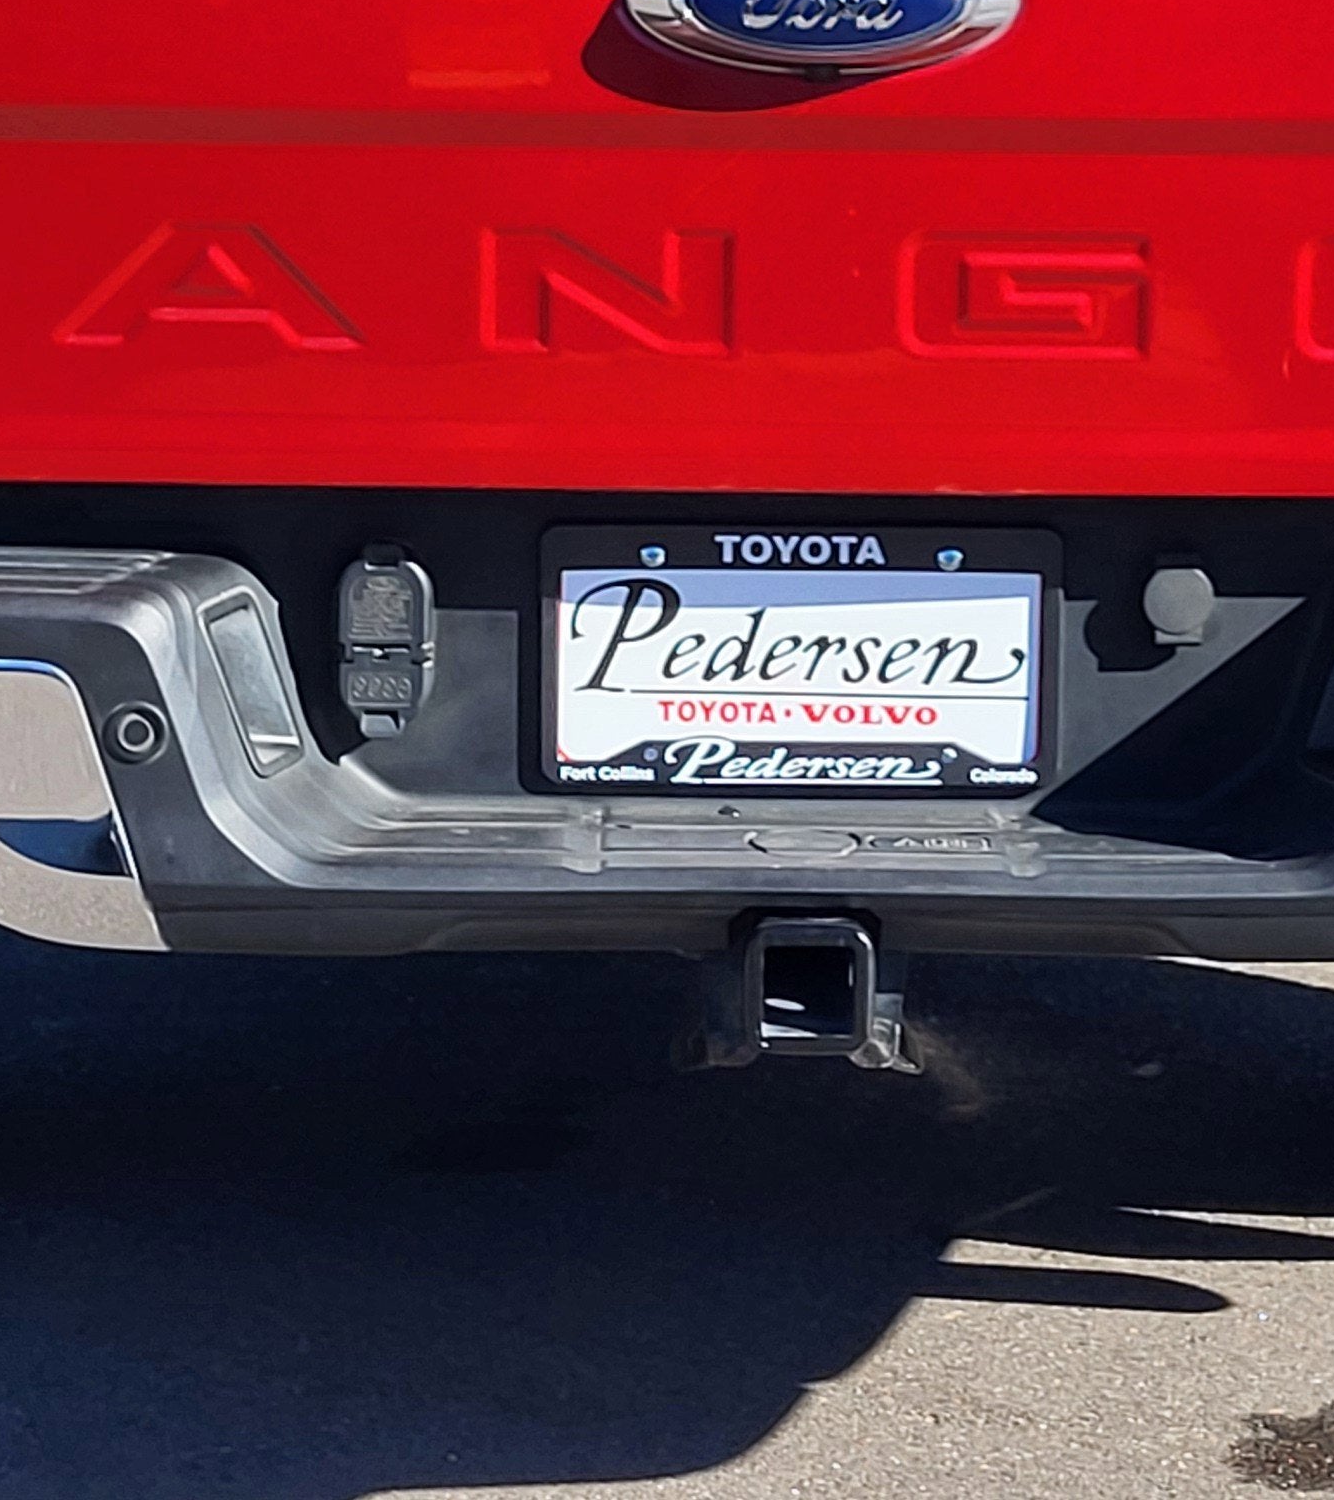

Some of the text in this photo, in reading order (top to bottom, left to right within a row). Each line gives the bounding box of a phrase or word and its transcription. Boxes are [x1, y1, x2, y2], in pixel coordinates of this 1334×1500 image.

[714, 533, 886, 566] TOYOTA
[570, 578, 1026, 693] Pedersen
[658, 701, 938, 726] TOYOTA VOLVO
[560, 765, 598, 781] Fort
[664, 736, 943, 785] Pedersen
